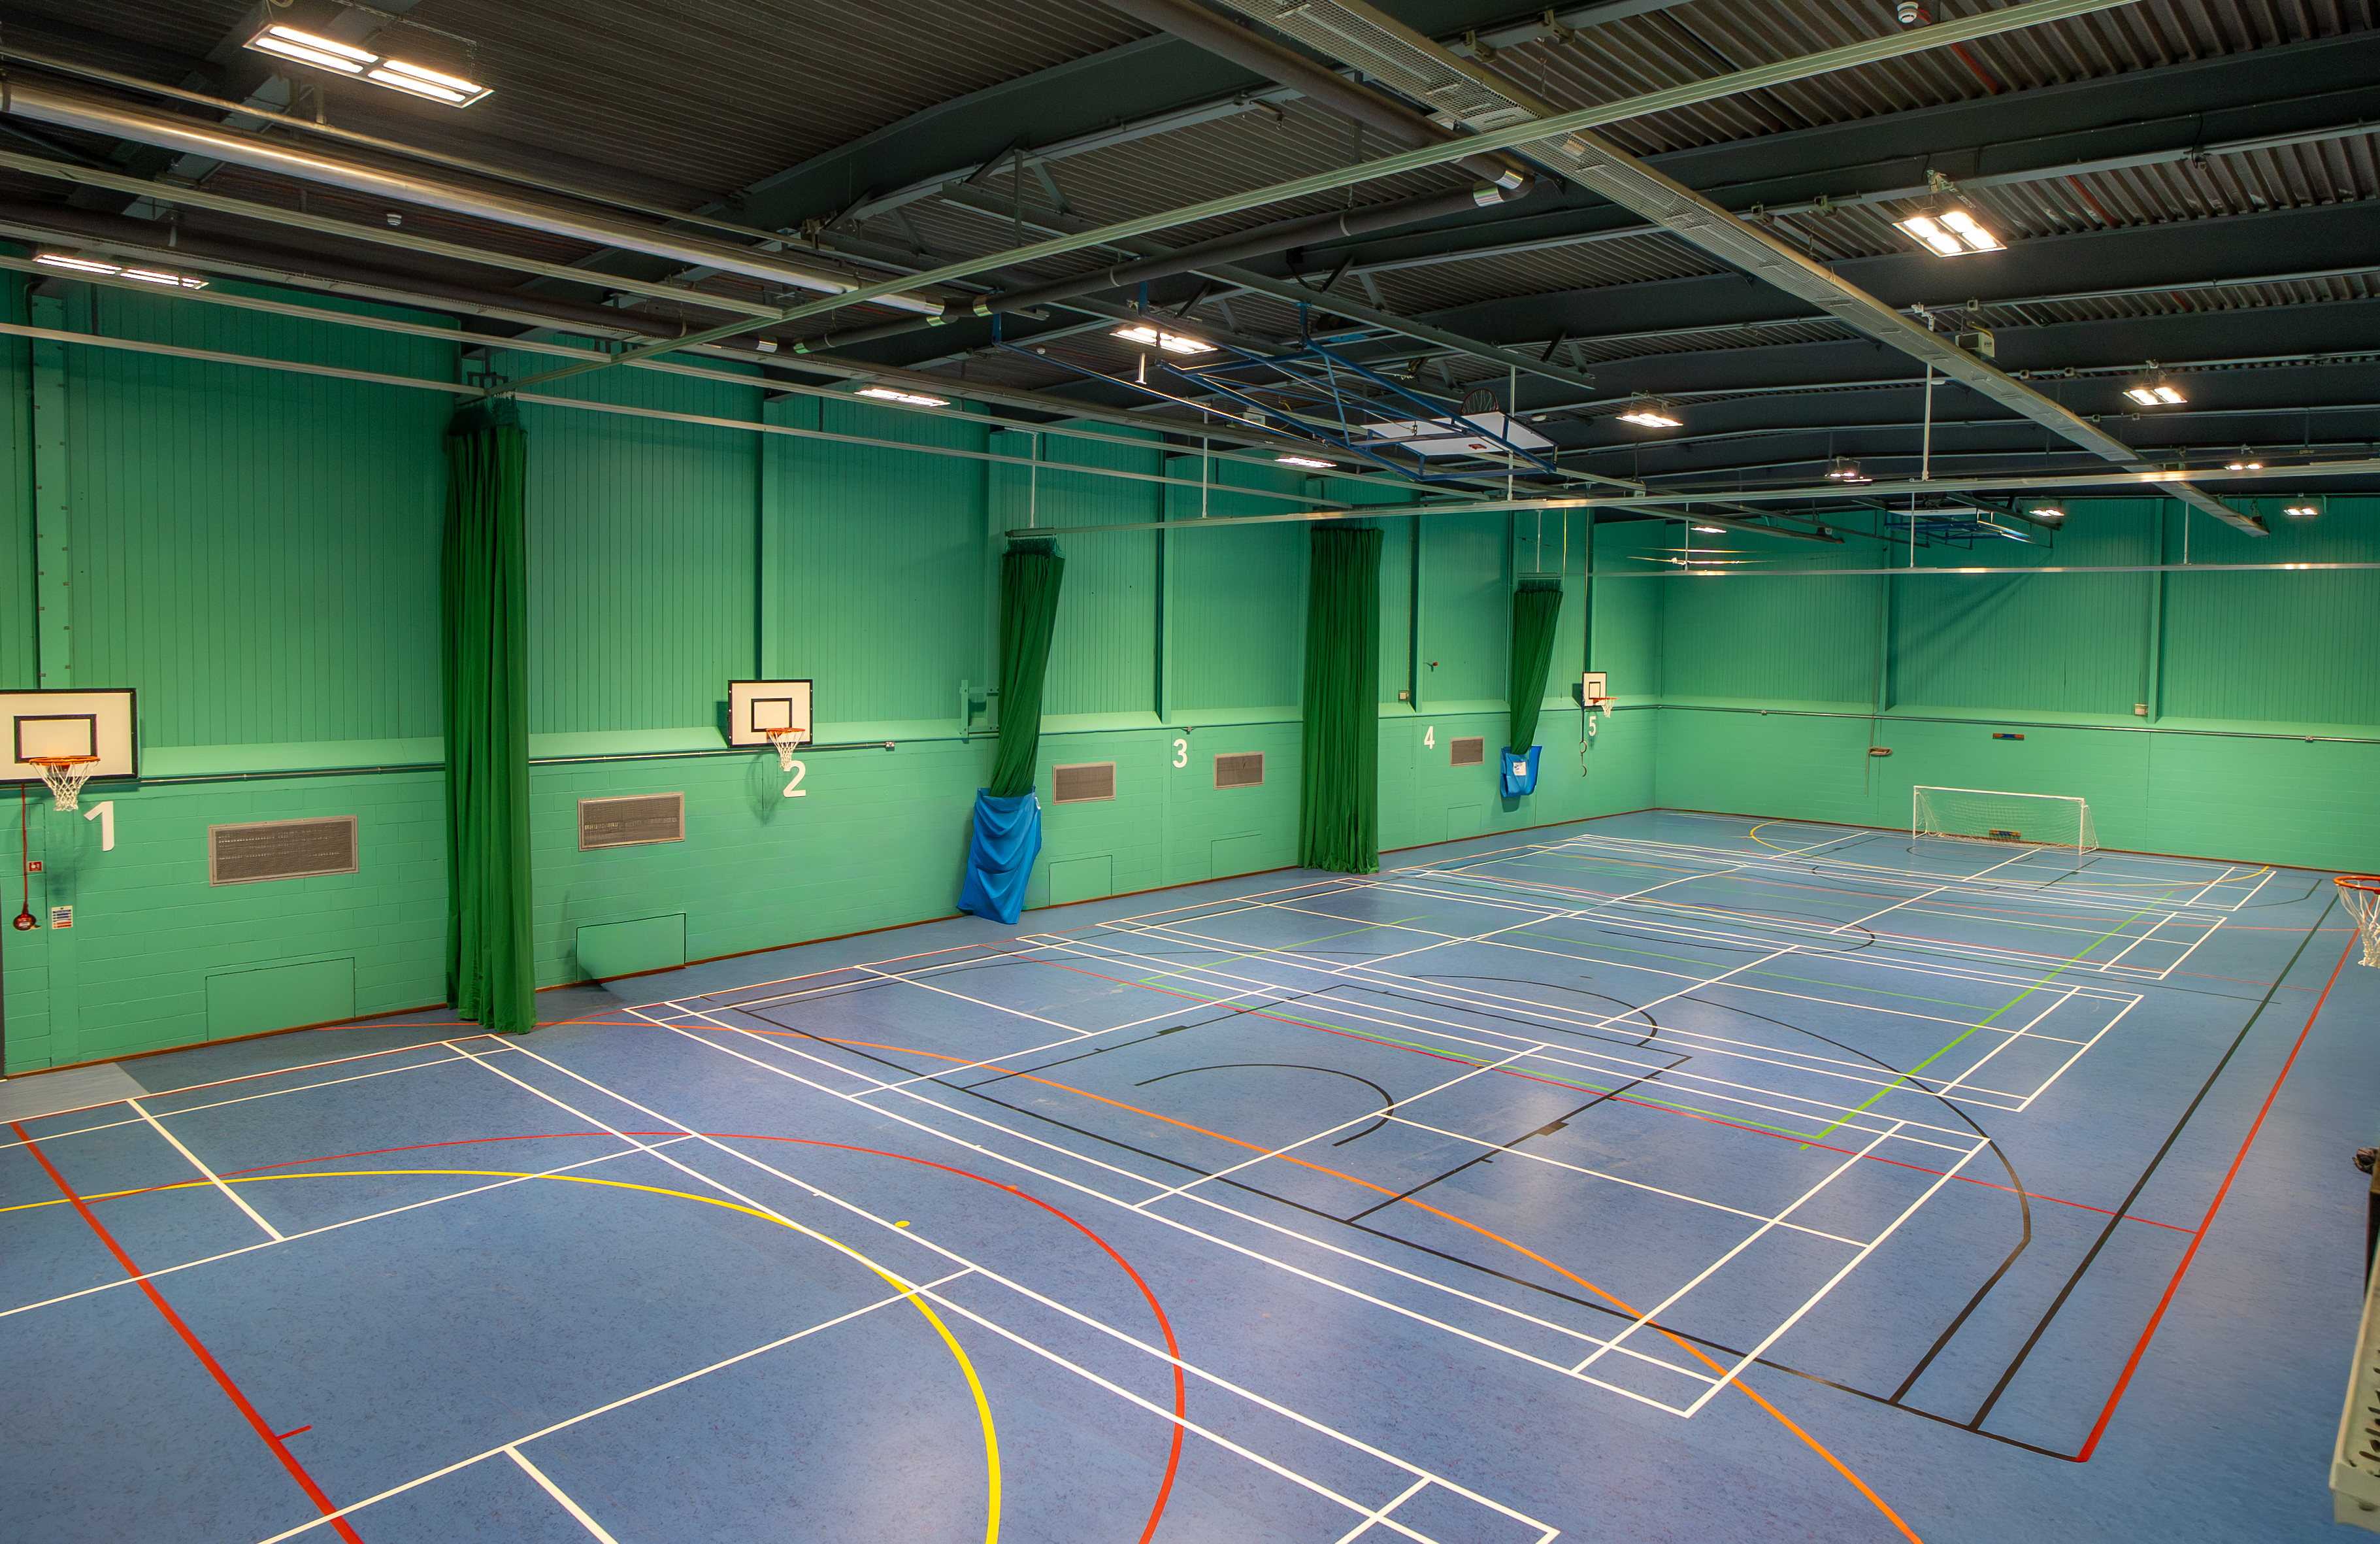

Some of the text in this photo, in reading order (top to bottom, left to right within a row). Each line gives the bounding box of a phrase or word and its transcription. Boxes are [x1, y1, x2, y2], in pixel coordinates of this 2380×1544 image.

[1424, 726, 1435, 750] 4
[1589, 716, 1596, 737] 5
[1172, 739, 1188, 769] 3
[783, 761, 806, 797] 2
[84, 801, 115, 852] 1
